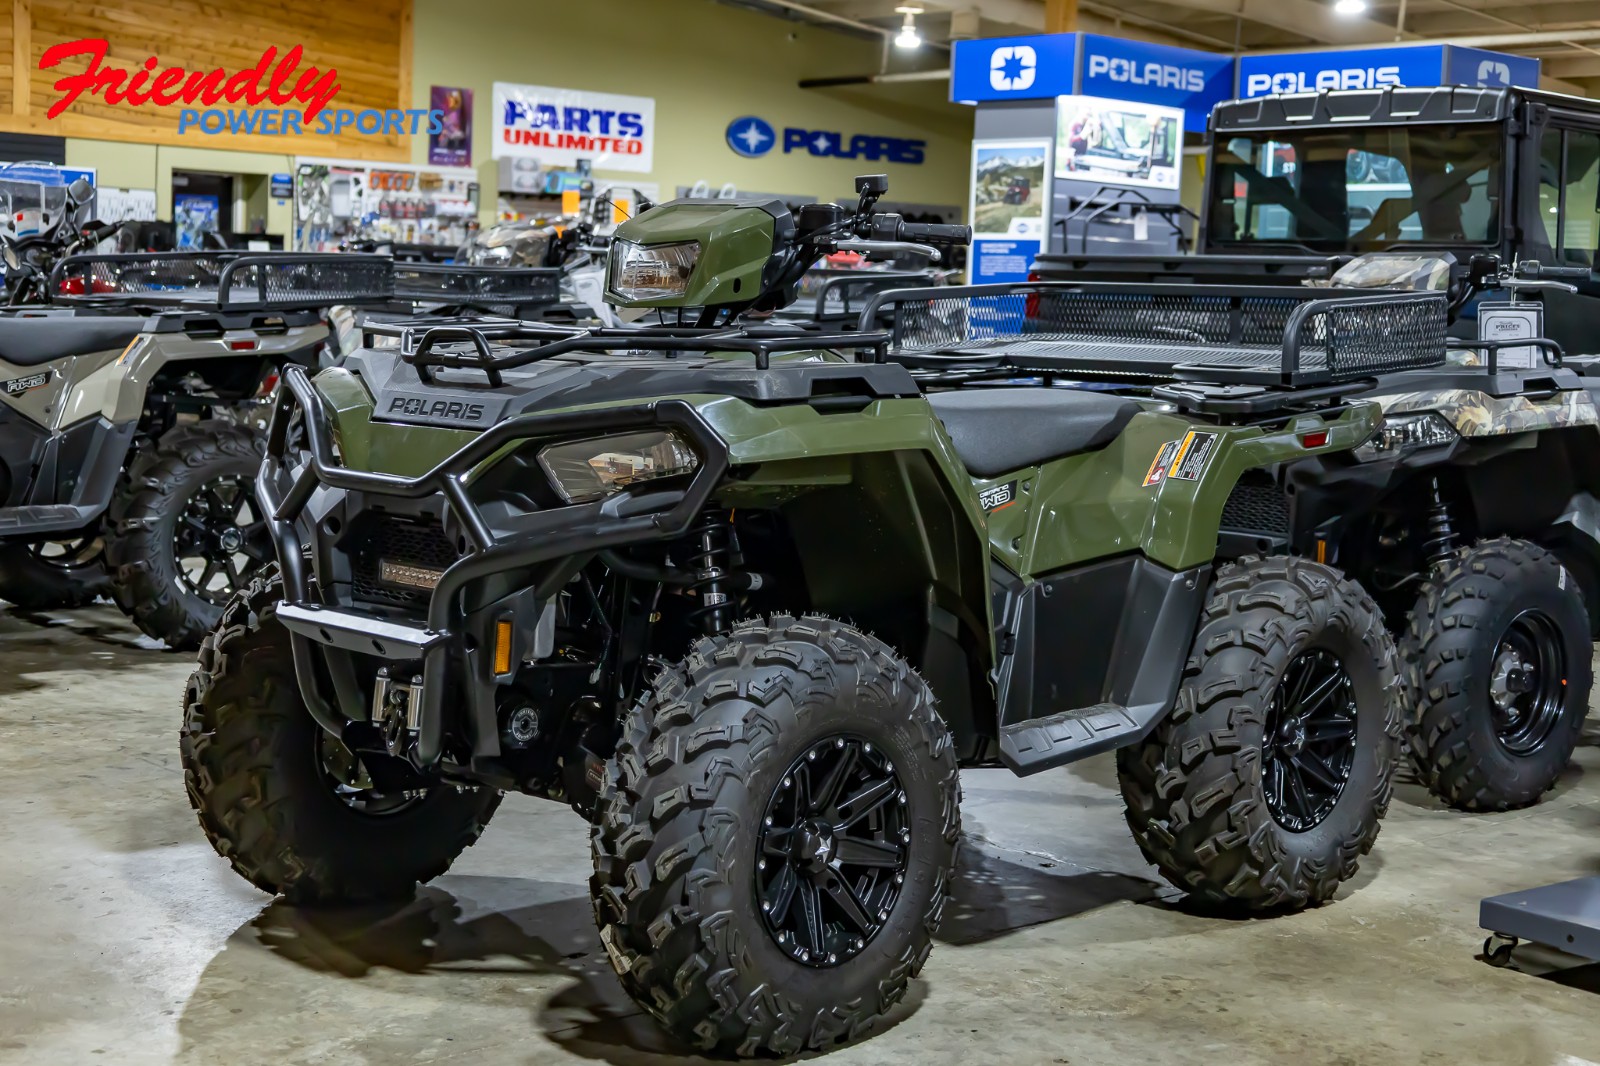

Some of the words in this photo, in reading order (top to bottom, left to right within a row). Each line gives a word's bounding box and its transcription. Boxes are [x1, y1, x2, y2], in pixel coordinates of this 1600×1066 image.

[1088, 54, 1205, 93] POLARIS
[1247, 66, 1400, 97] POLARIS
[504, 99, 644, 139] PARTS
[503, 128, 644, 156] UNLIMITED
[783, 127, 926, 165] POLARIS
[387, 397, 485, 421] POLARIS
